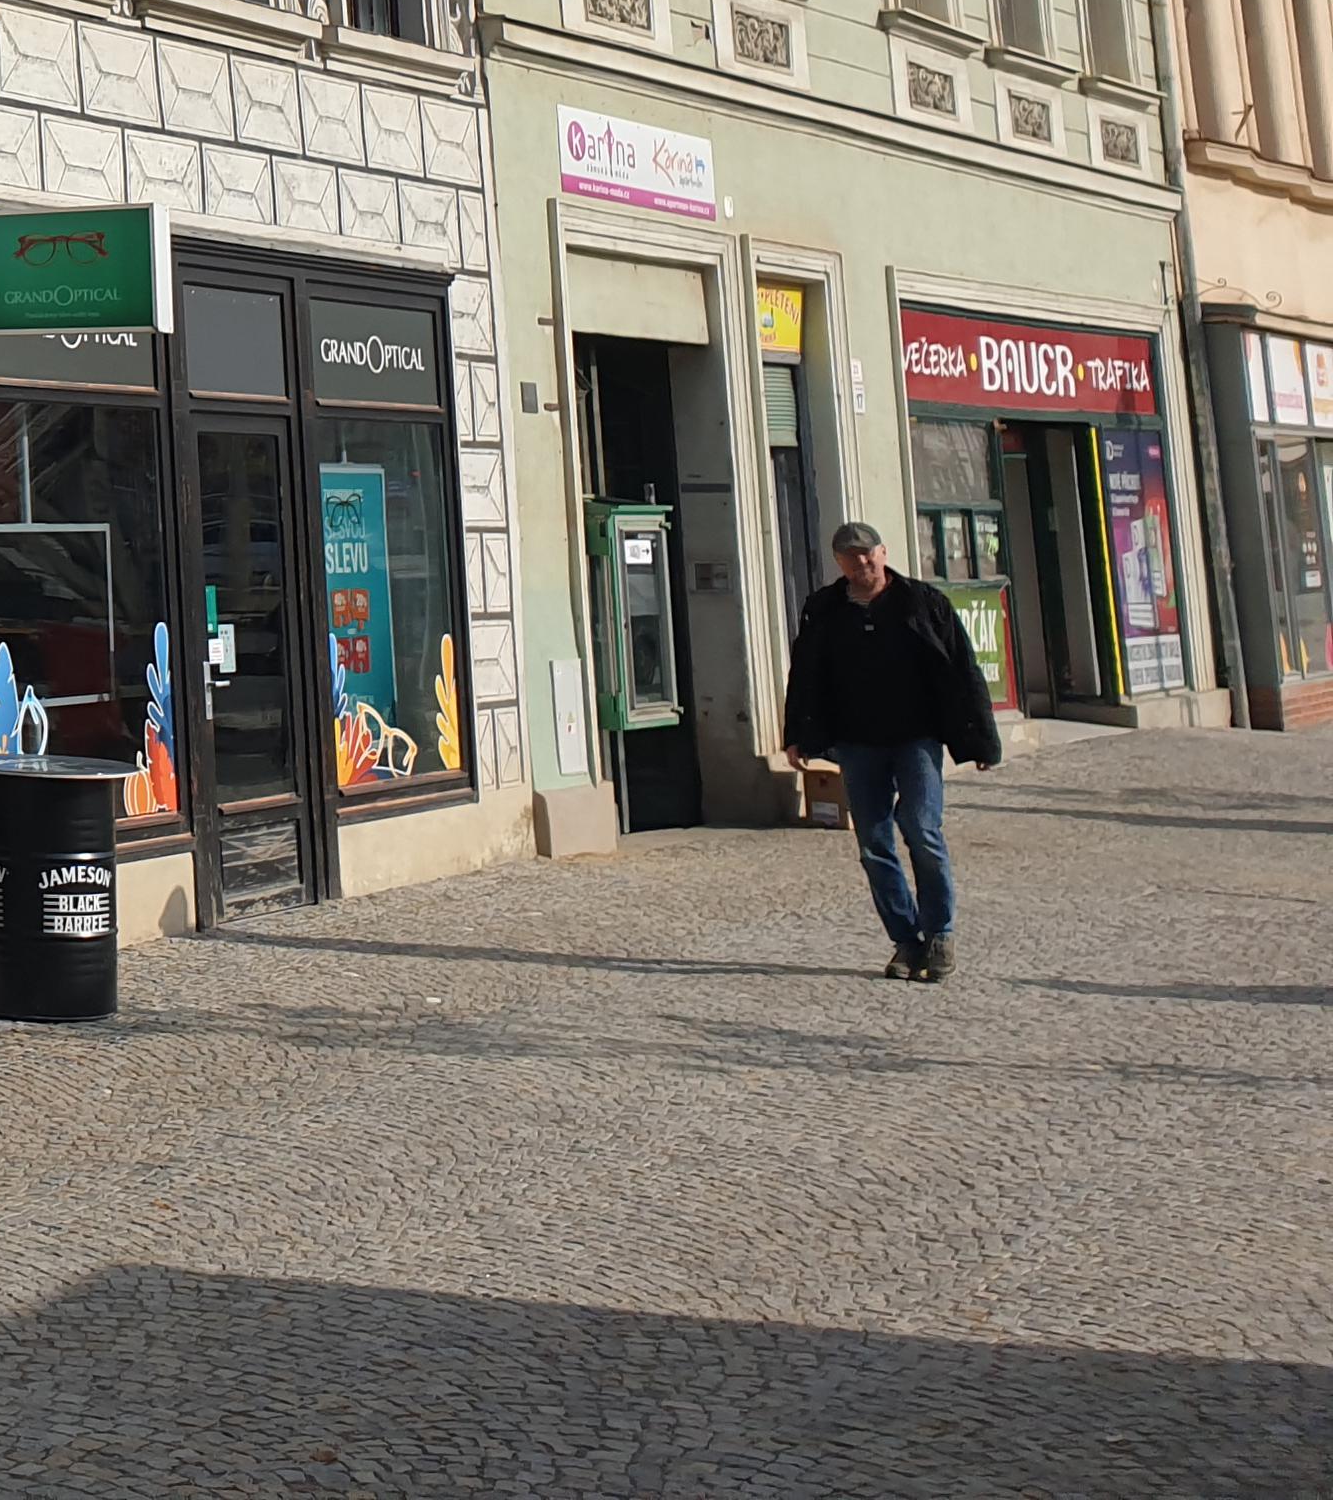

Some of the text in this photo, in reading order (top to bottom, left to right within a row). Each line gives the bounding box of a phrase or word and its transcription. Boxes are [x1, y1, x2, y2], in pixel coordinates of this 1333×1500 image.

[979, 336, 1076, 397] BAUER
[1087, 357, 1151, 392] TRAFIKA
[324, 542, 369, 574] SLEVU
[38, 865, 111, 889] JAMESON
[59, 894, 101, 912] BLACK
[54, 914, 104, 932] BARREL
